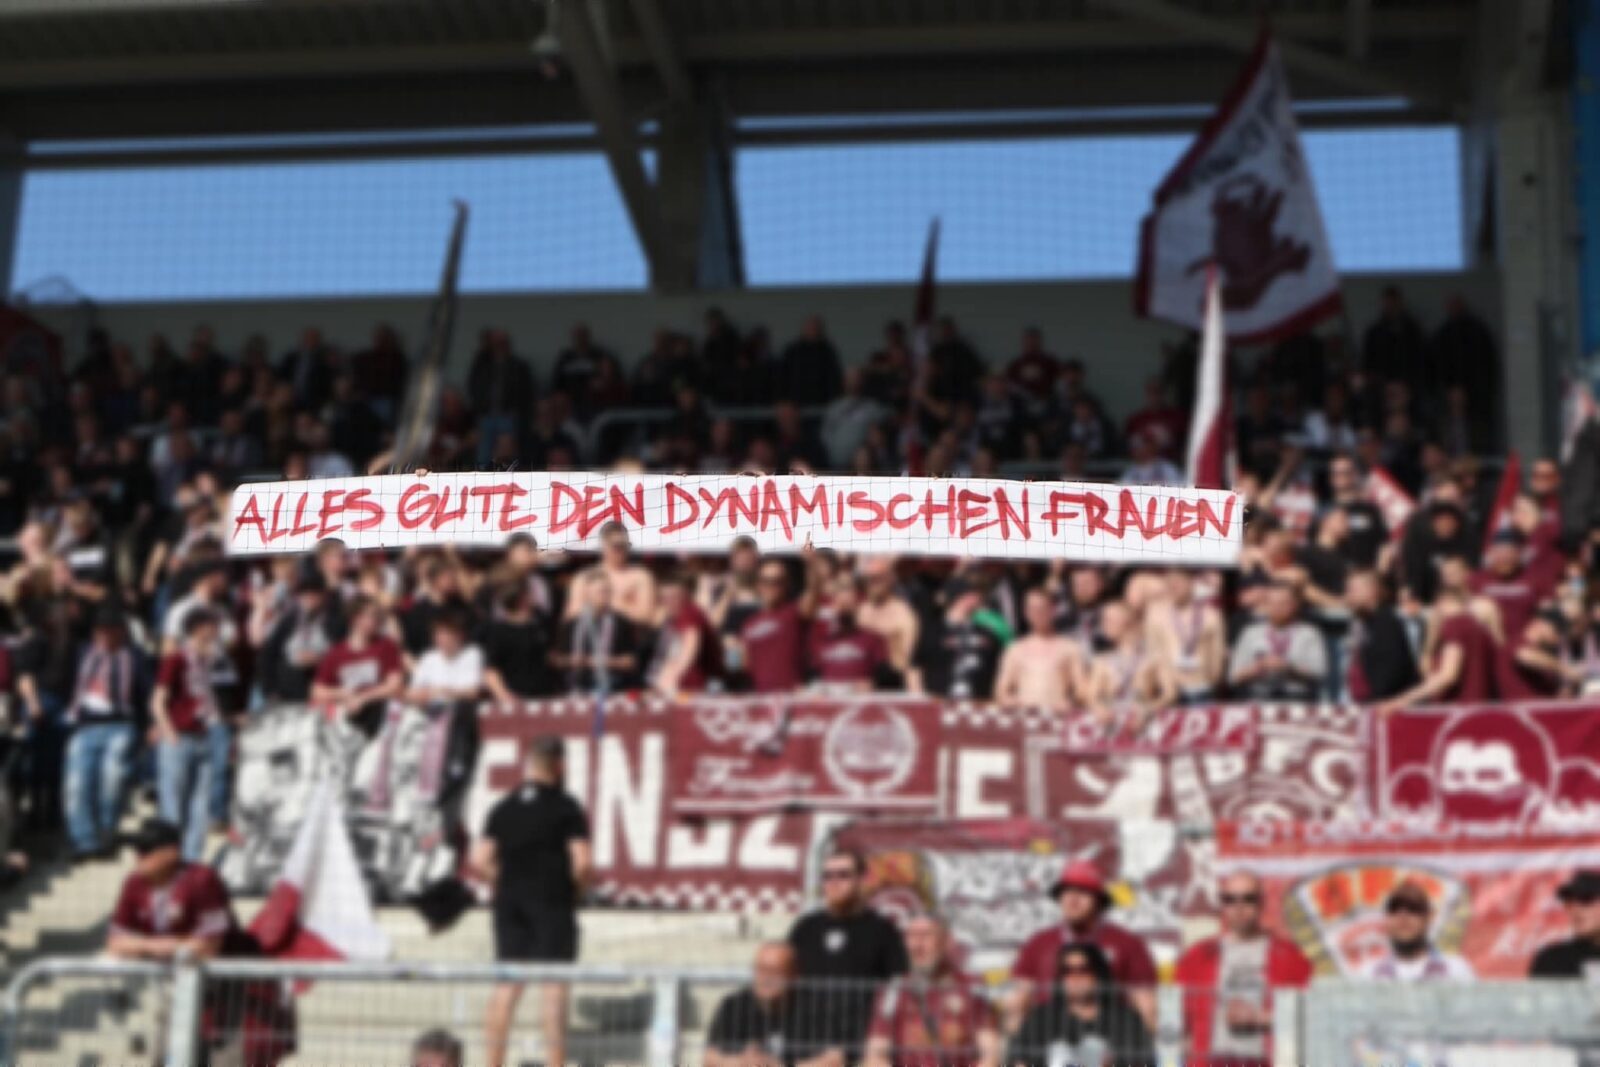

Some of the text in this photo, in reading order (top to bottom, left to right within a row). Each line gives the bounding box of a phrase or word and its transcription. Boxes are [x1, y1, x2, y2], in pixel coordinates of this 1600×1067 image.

[233, 478, 1237, 543] ALLES GUTE DEN DYNAMISCHEN FRAUEN
